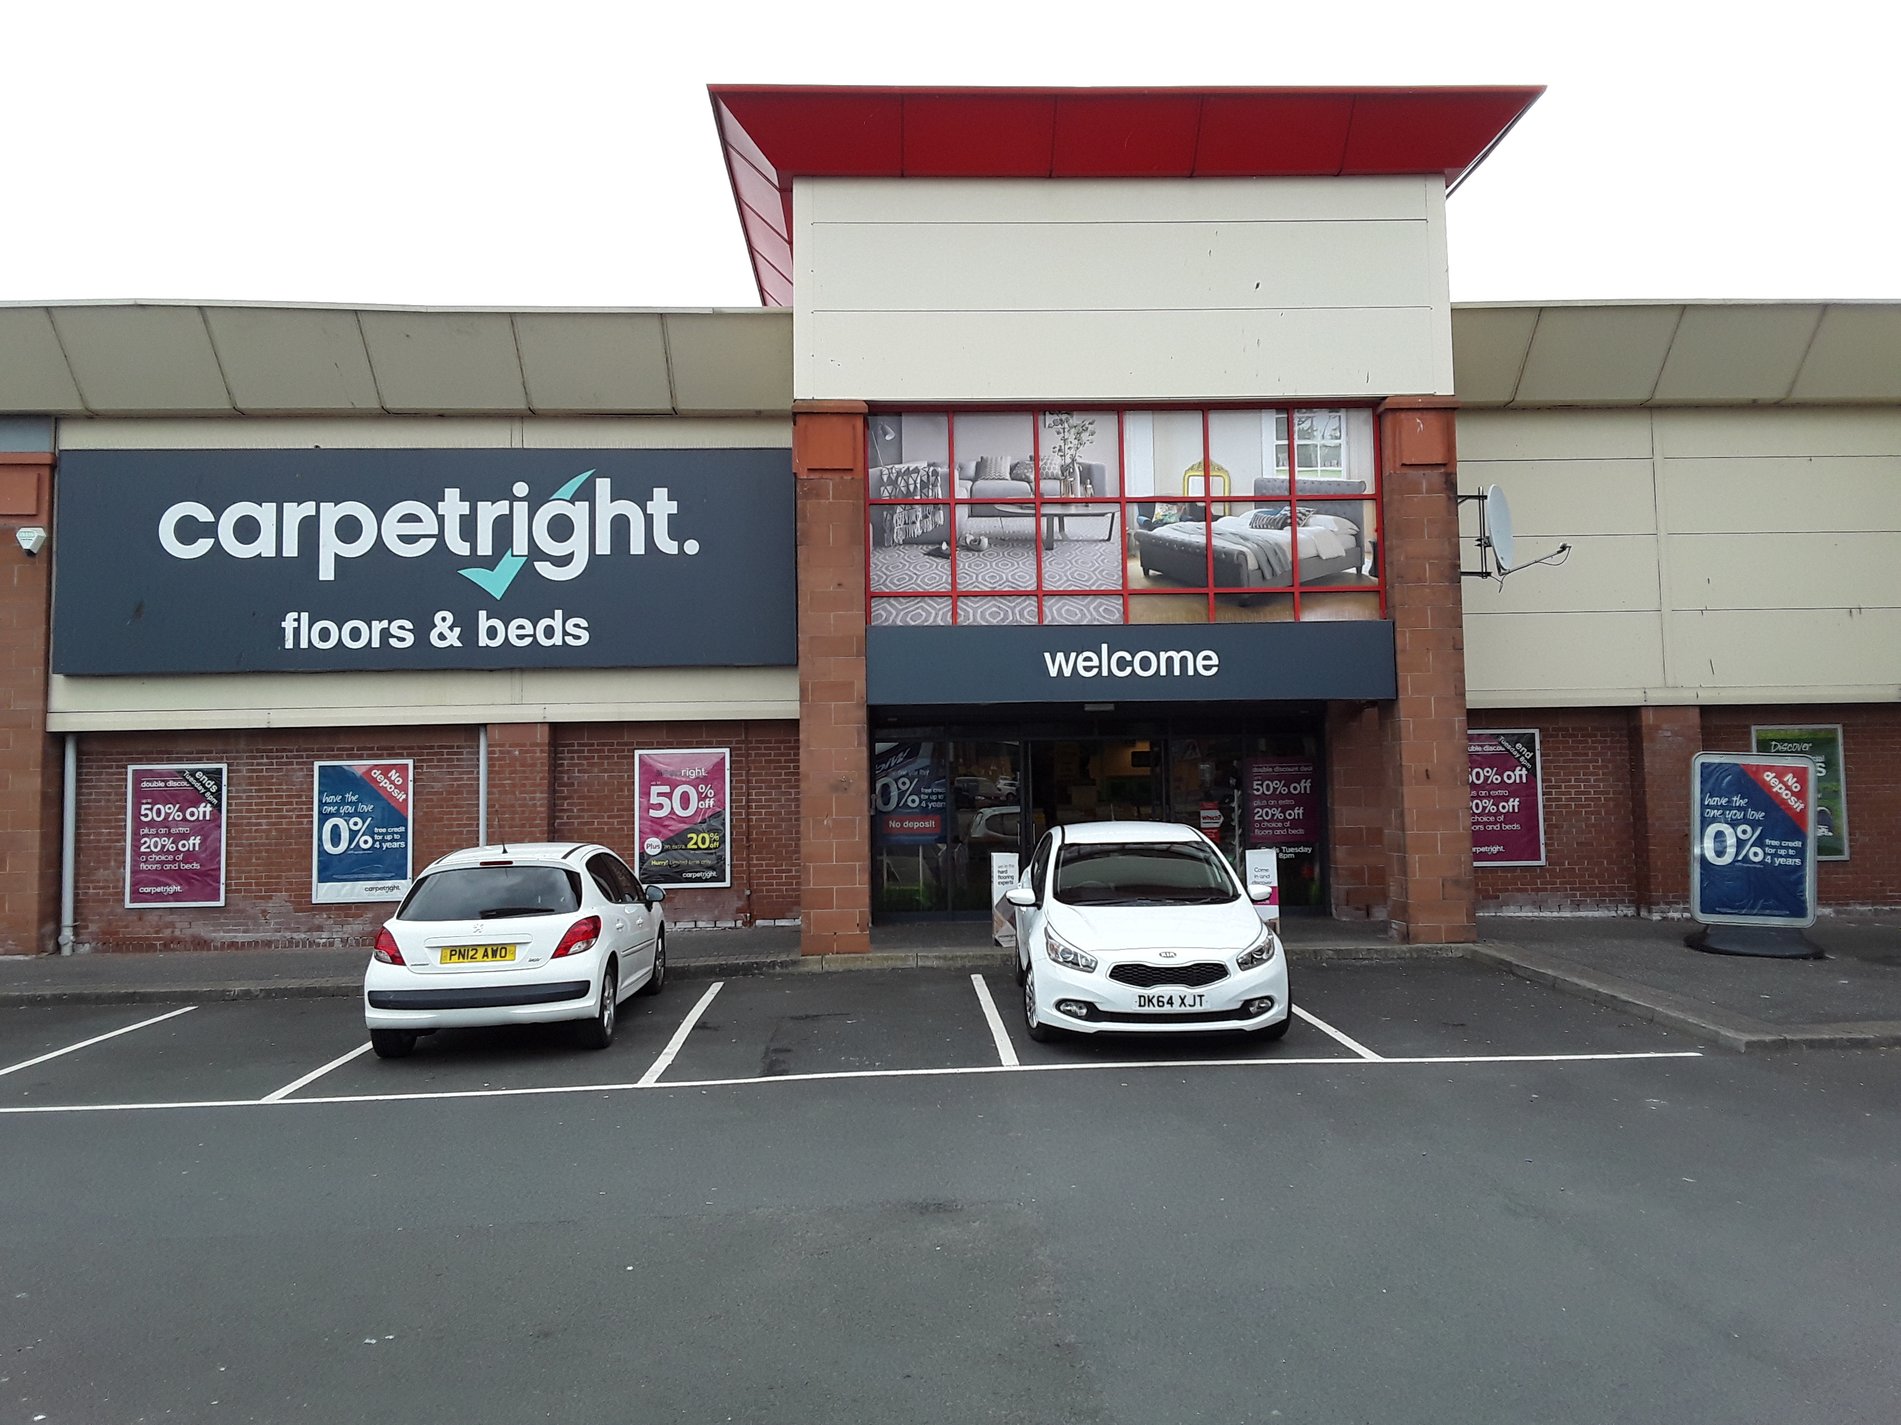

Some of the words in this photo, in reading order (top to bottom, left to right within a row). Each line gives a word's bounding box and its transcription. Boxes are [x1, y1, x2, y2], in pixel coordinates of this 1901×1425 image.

[281, 611, 414, 650] floors
[430, 611, 463, 648] &
[479, 609, 590, 648] beds
[1043, 643, 1219, 677] welcome
[1499, 736, 1520, 759] Tuesday
[1519, 756, 1532, 769] 8pm
[1771, 741, 1813, 752] Discover
[195, 770, 218, 793] ends
[388, 769, 403, 785] No
[1504, 766, 1528, 784] off
[1784, 772, 1801, 792] No
[140, 780, 165, 788] double
[183, 770, 205, 794] Tuesday
[204, 792, 218, 805] 8pm
[371, 769, 407, 802] deposit
[1253, 780, 1288, 795] 50%
[1290, 779, 1312, 794] off
[322, 792, 342, 804] have
[344, 792, 359, 803] the
[876, 776, 920, 812] 0%
[1763, 771, 1805, 813] deposit
[699, 798, 715, 809] off
[928, 802, 946, 810] year
[1470, 799, 1497, 814] 0%
[1499, 798, 1520, 813] off
[1704, 793, 1729, 806] have
[1732, 794, 1749, 807] the
[140, 804, 183, 822] 50%
[186, 803, 212, 821] off
[322, 804, 337, 814] one
[340, 804, 355, 816] you
[357, 802, 374, 813] love
[1254, 808, 1284, 821] 20%
[1286, 807, 1304, 820] off
[1705, 808, 1722, 819] one
[1726, 808, 1744, 823] you
[1748, 808, 1766, 820] love
[140, 827, 156, 836] plus
[889, 820, 901, 828] No
[903, 820, 936, 829] deposit
[1502, 823, 1521, 831] beds
[322, 816, 373, 855] 0%
[140, 838, 176, 852] 20%
[178, 836, 201, 851] off
[382, 842, 406, 850] years
[646, 843, 661, 851] Plus
[1282, 846, 1313, 854] Tuesday
[1704, 822, 1765, 866] 0%
[1766, 838, 1780, 847] free
[1782, 839, 1802, 848] credit
[148, 854, 174, 862] choice
[1766, 846, 1776, 855] for
[1778, 848, 1787, 856] up
[140, 862, 161, 871] floors
[163, 862, 179, 870] and
[180, 862, 201, 870] beds
[1766, 856, 1772, 864] 4
[1774, 856, 1802, 866] years
[450, 948, 477, 961] PN12
[482, 946, 507, 960] AWO
[1138, 994, 1174, 1008] DK64
[1178, 995, 1205, 1007] XJT
